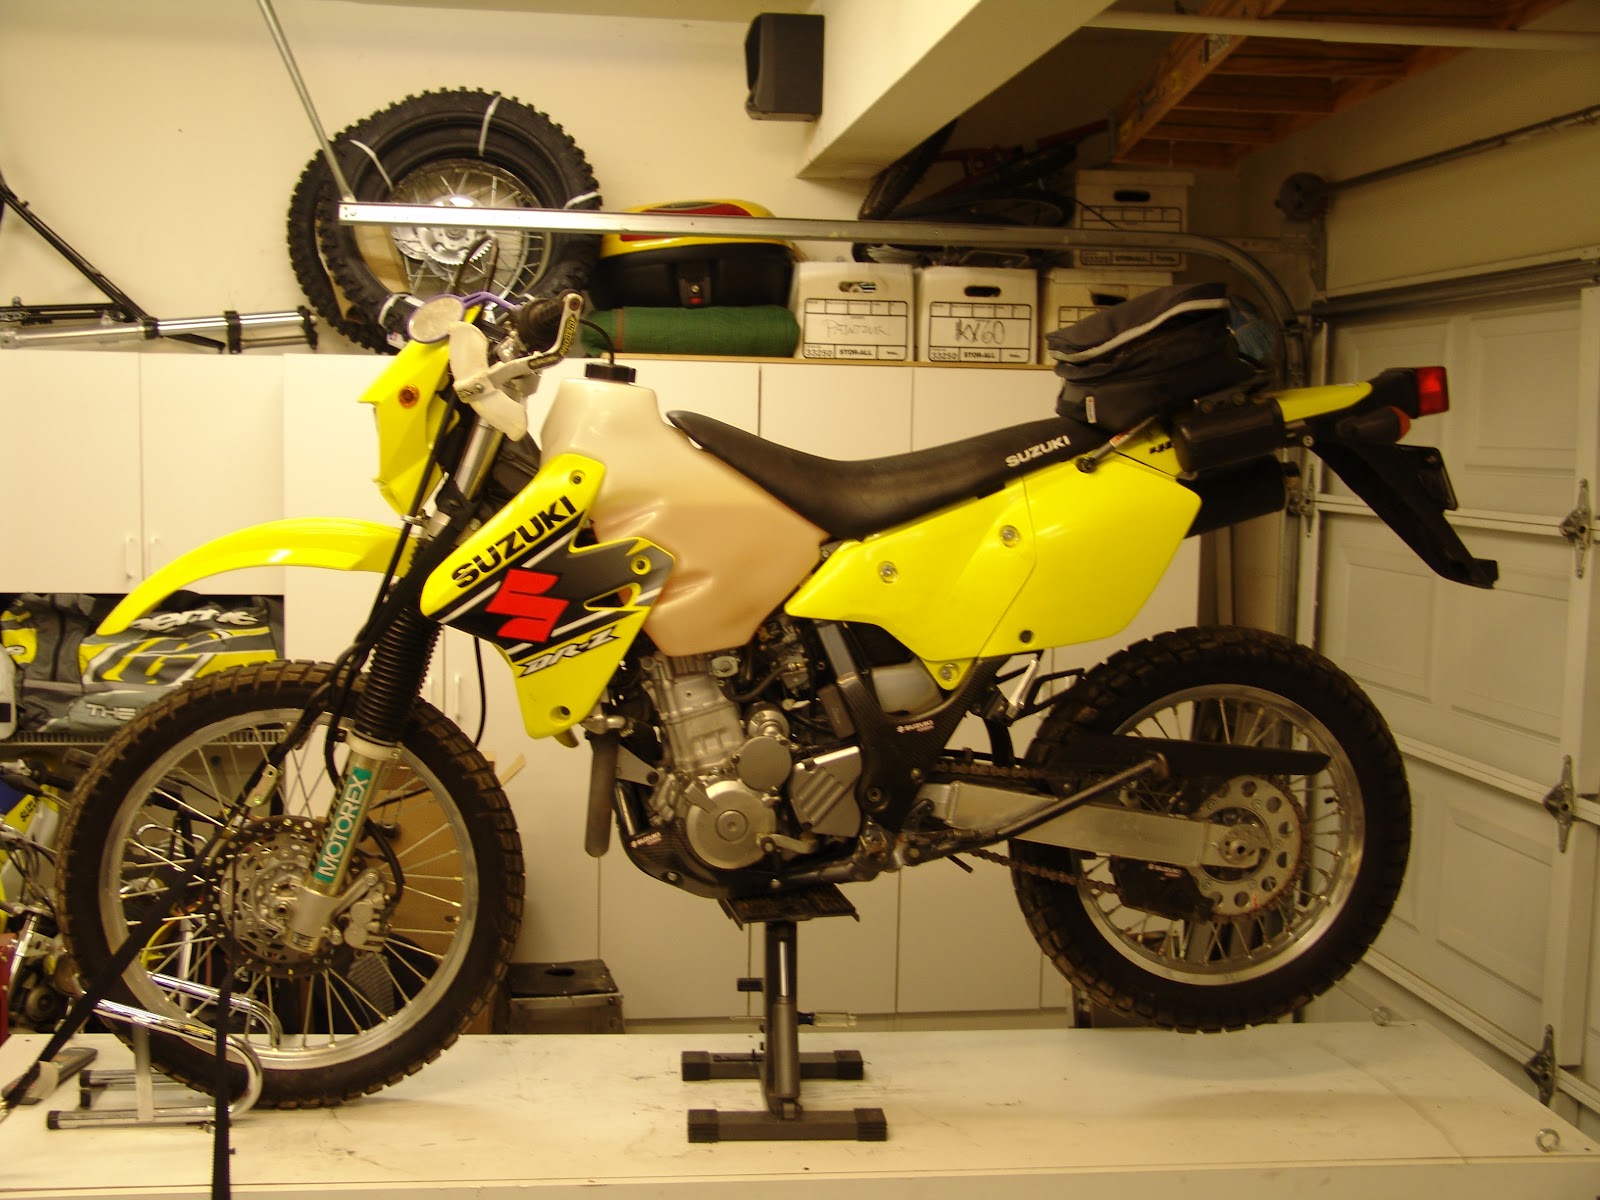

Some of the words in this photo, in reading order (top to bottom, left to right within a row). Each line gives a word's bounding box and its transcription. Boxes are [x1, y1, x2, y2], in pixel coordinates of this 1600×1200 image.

[1004, 435, 1072, 468] SUZUKI
[452, 496, 577, 589] SUZUKI
[317, 773, 369, 878] MOTOREX
